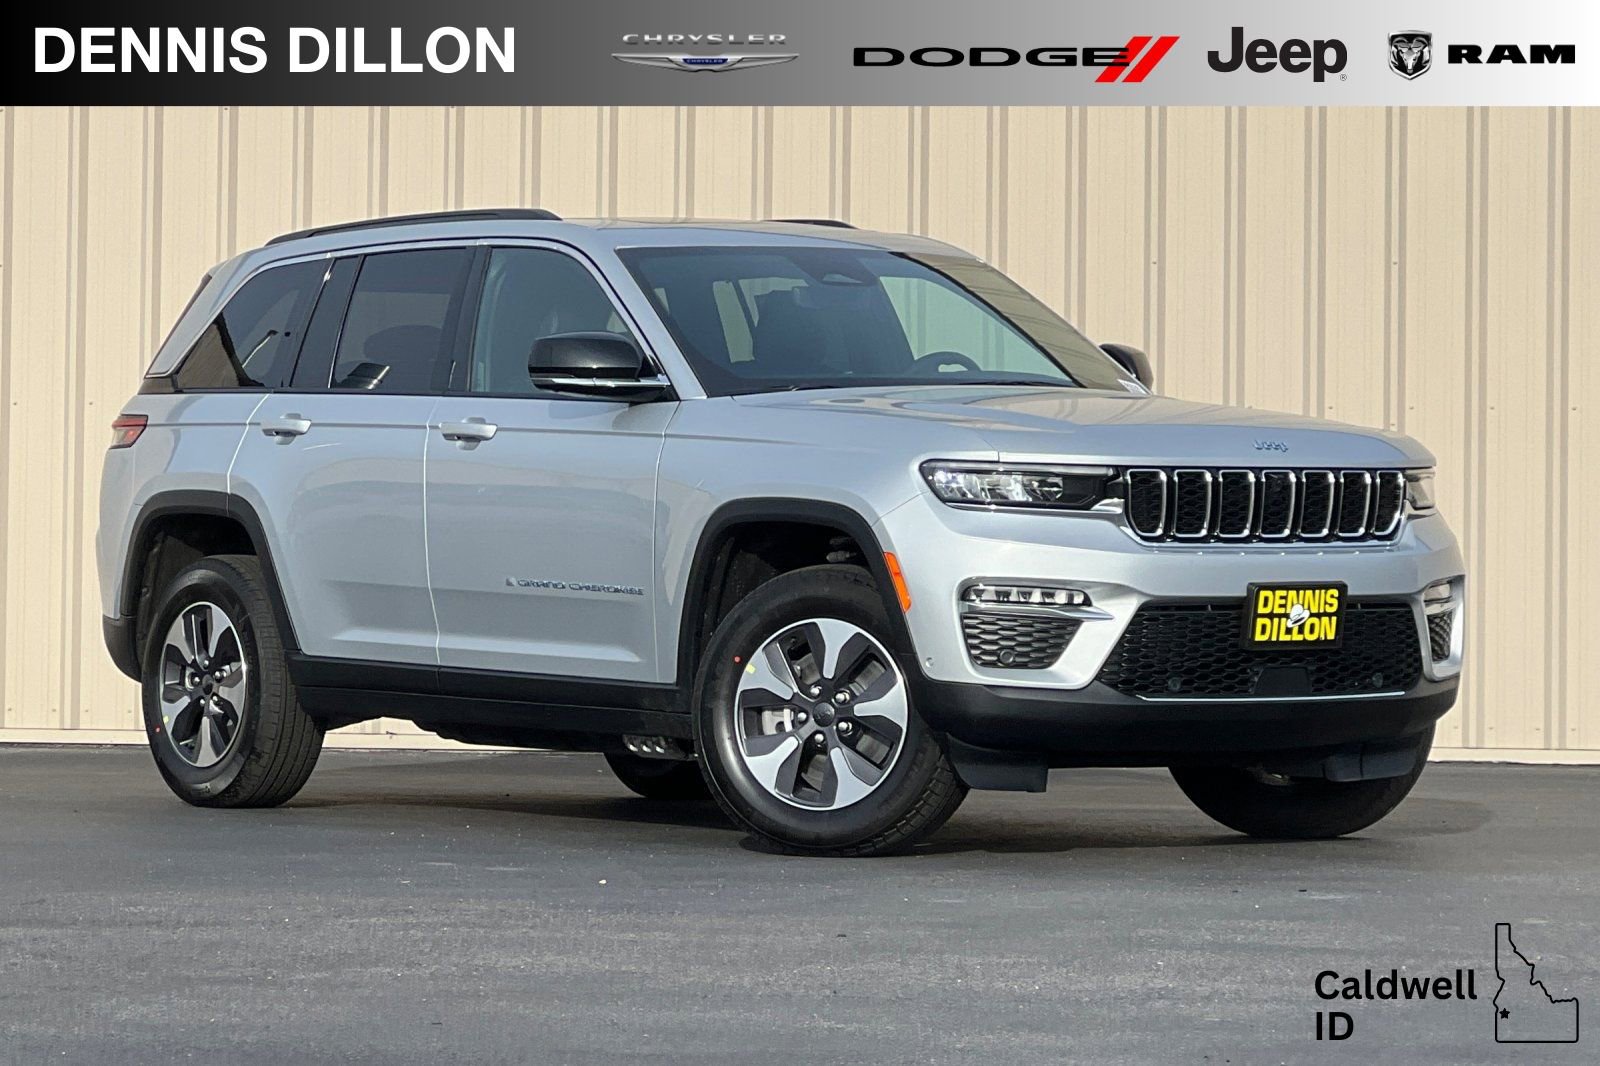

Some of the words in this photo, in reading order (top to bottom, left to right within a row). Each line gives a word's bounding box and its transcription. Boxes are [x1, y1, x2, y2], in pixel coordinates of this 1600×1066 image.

[1253, 440, 1289, 453] Jeep
[517, 579, 566, 589] GRAND
[569, 583, 644, 595] CHEROKEE
[1257, 588, 1339, 613] DENNIS
[1254, 616, 1337, 641] DILLON
